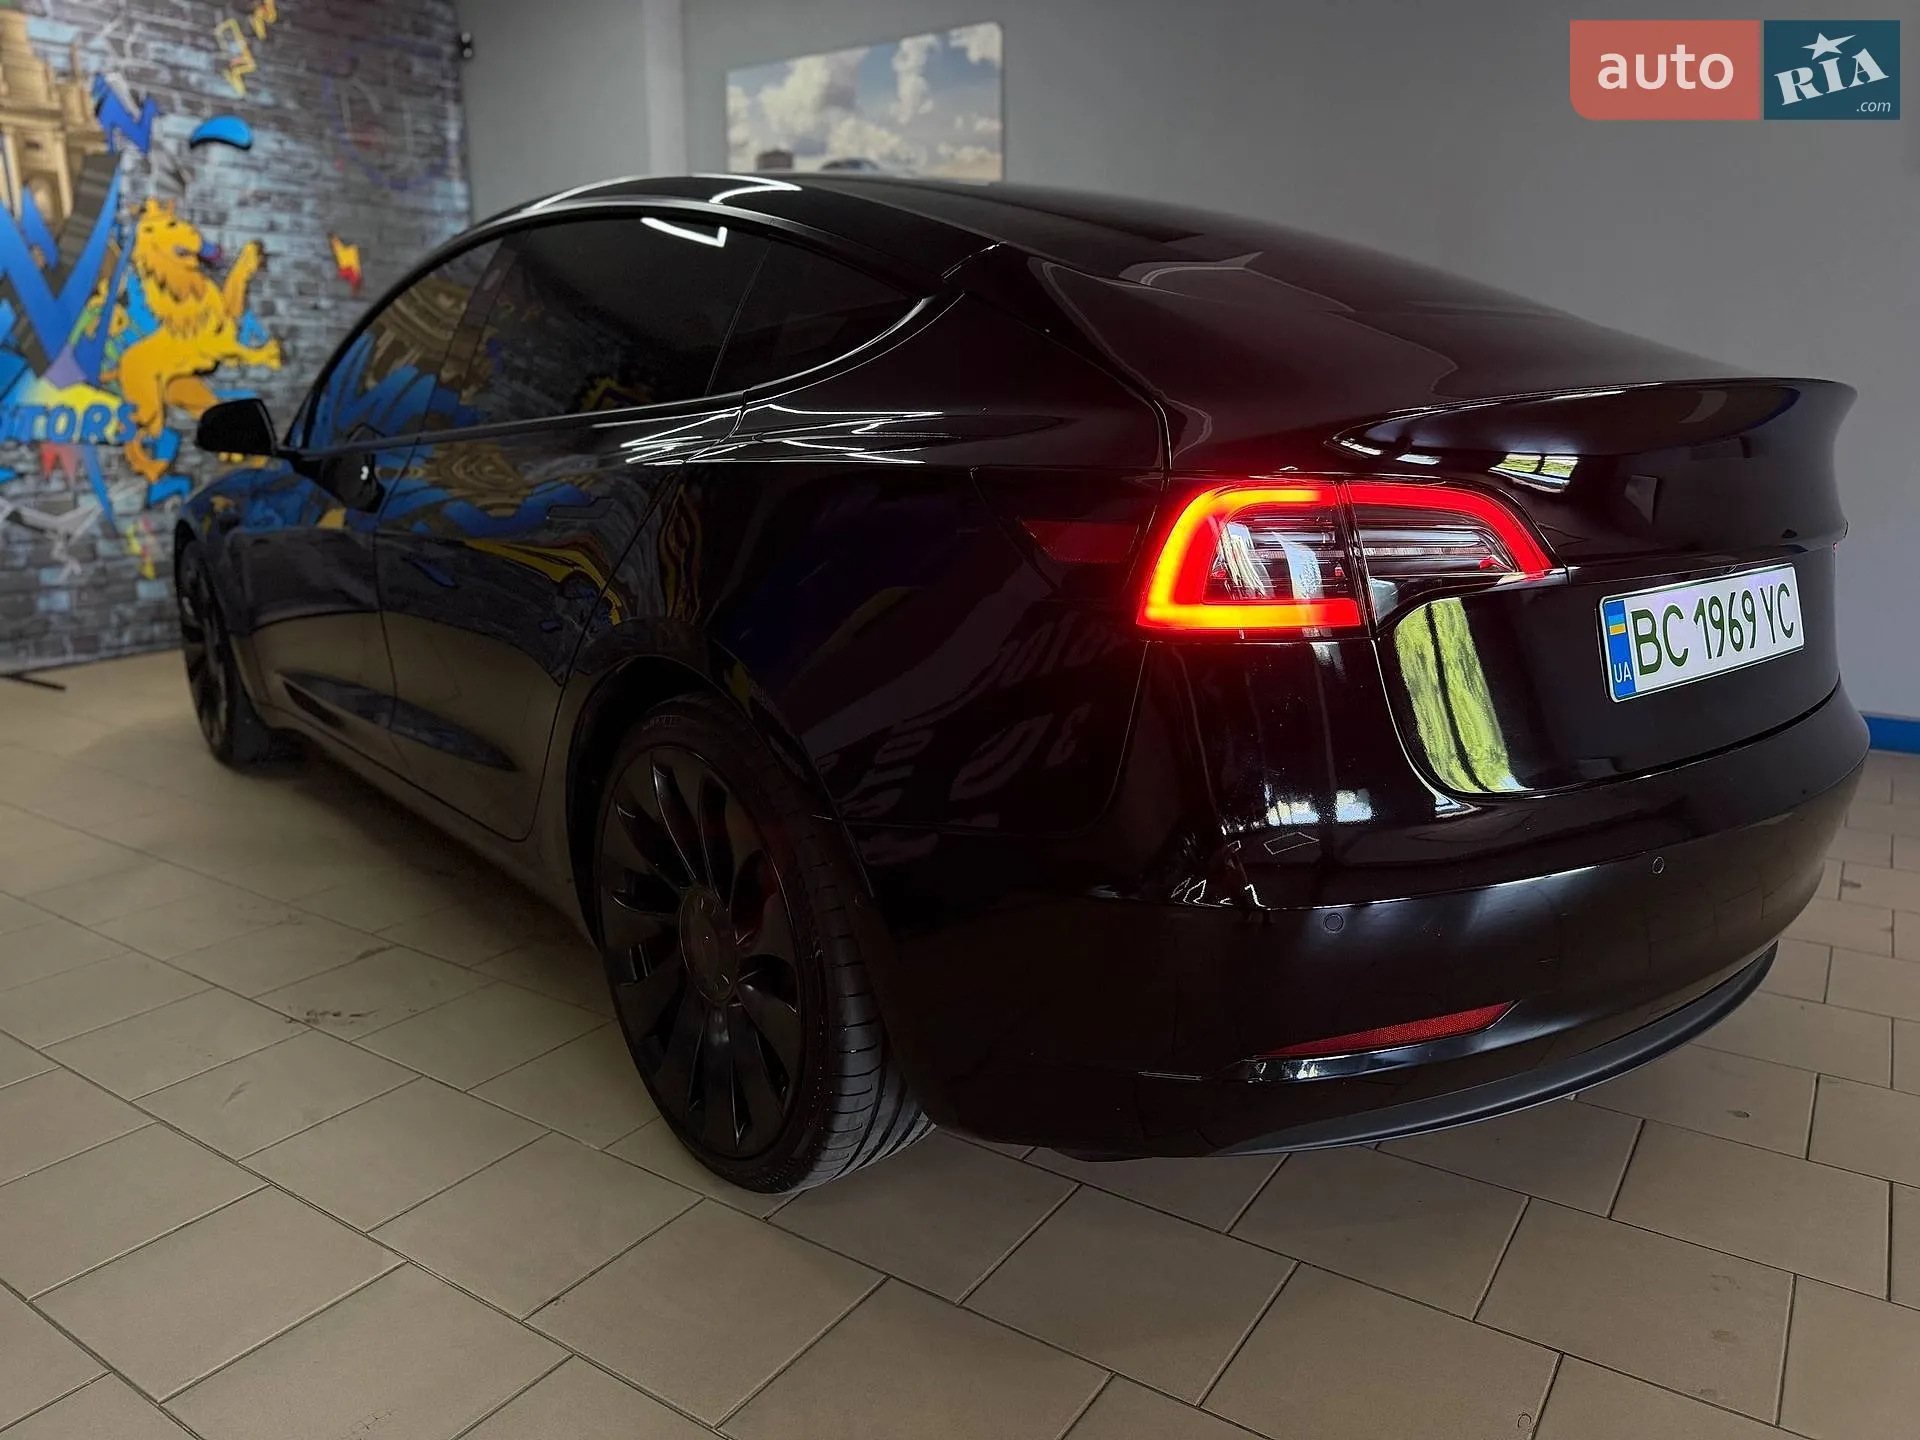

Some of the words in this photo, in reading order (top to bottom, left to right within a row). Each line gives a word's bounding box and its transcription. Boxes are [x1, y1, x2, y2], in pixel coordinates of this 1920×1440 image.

[1631, 604, 1689, 675] BC
[1693, 589, 1757, 660] 1969
[1760, 583, 1794, 644] YC
[1613, 661, 1632, 683] UA
